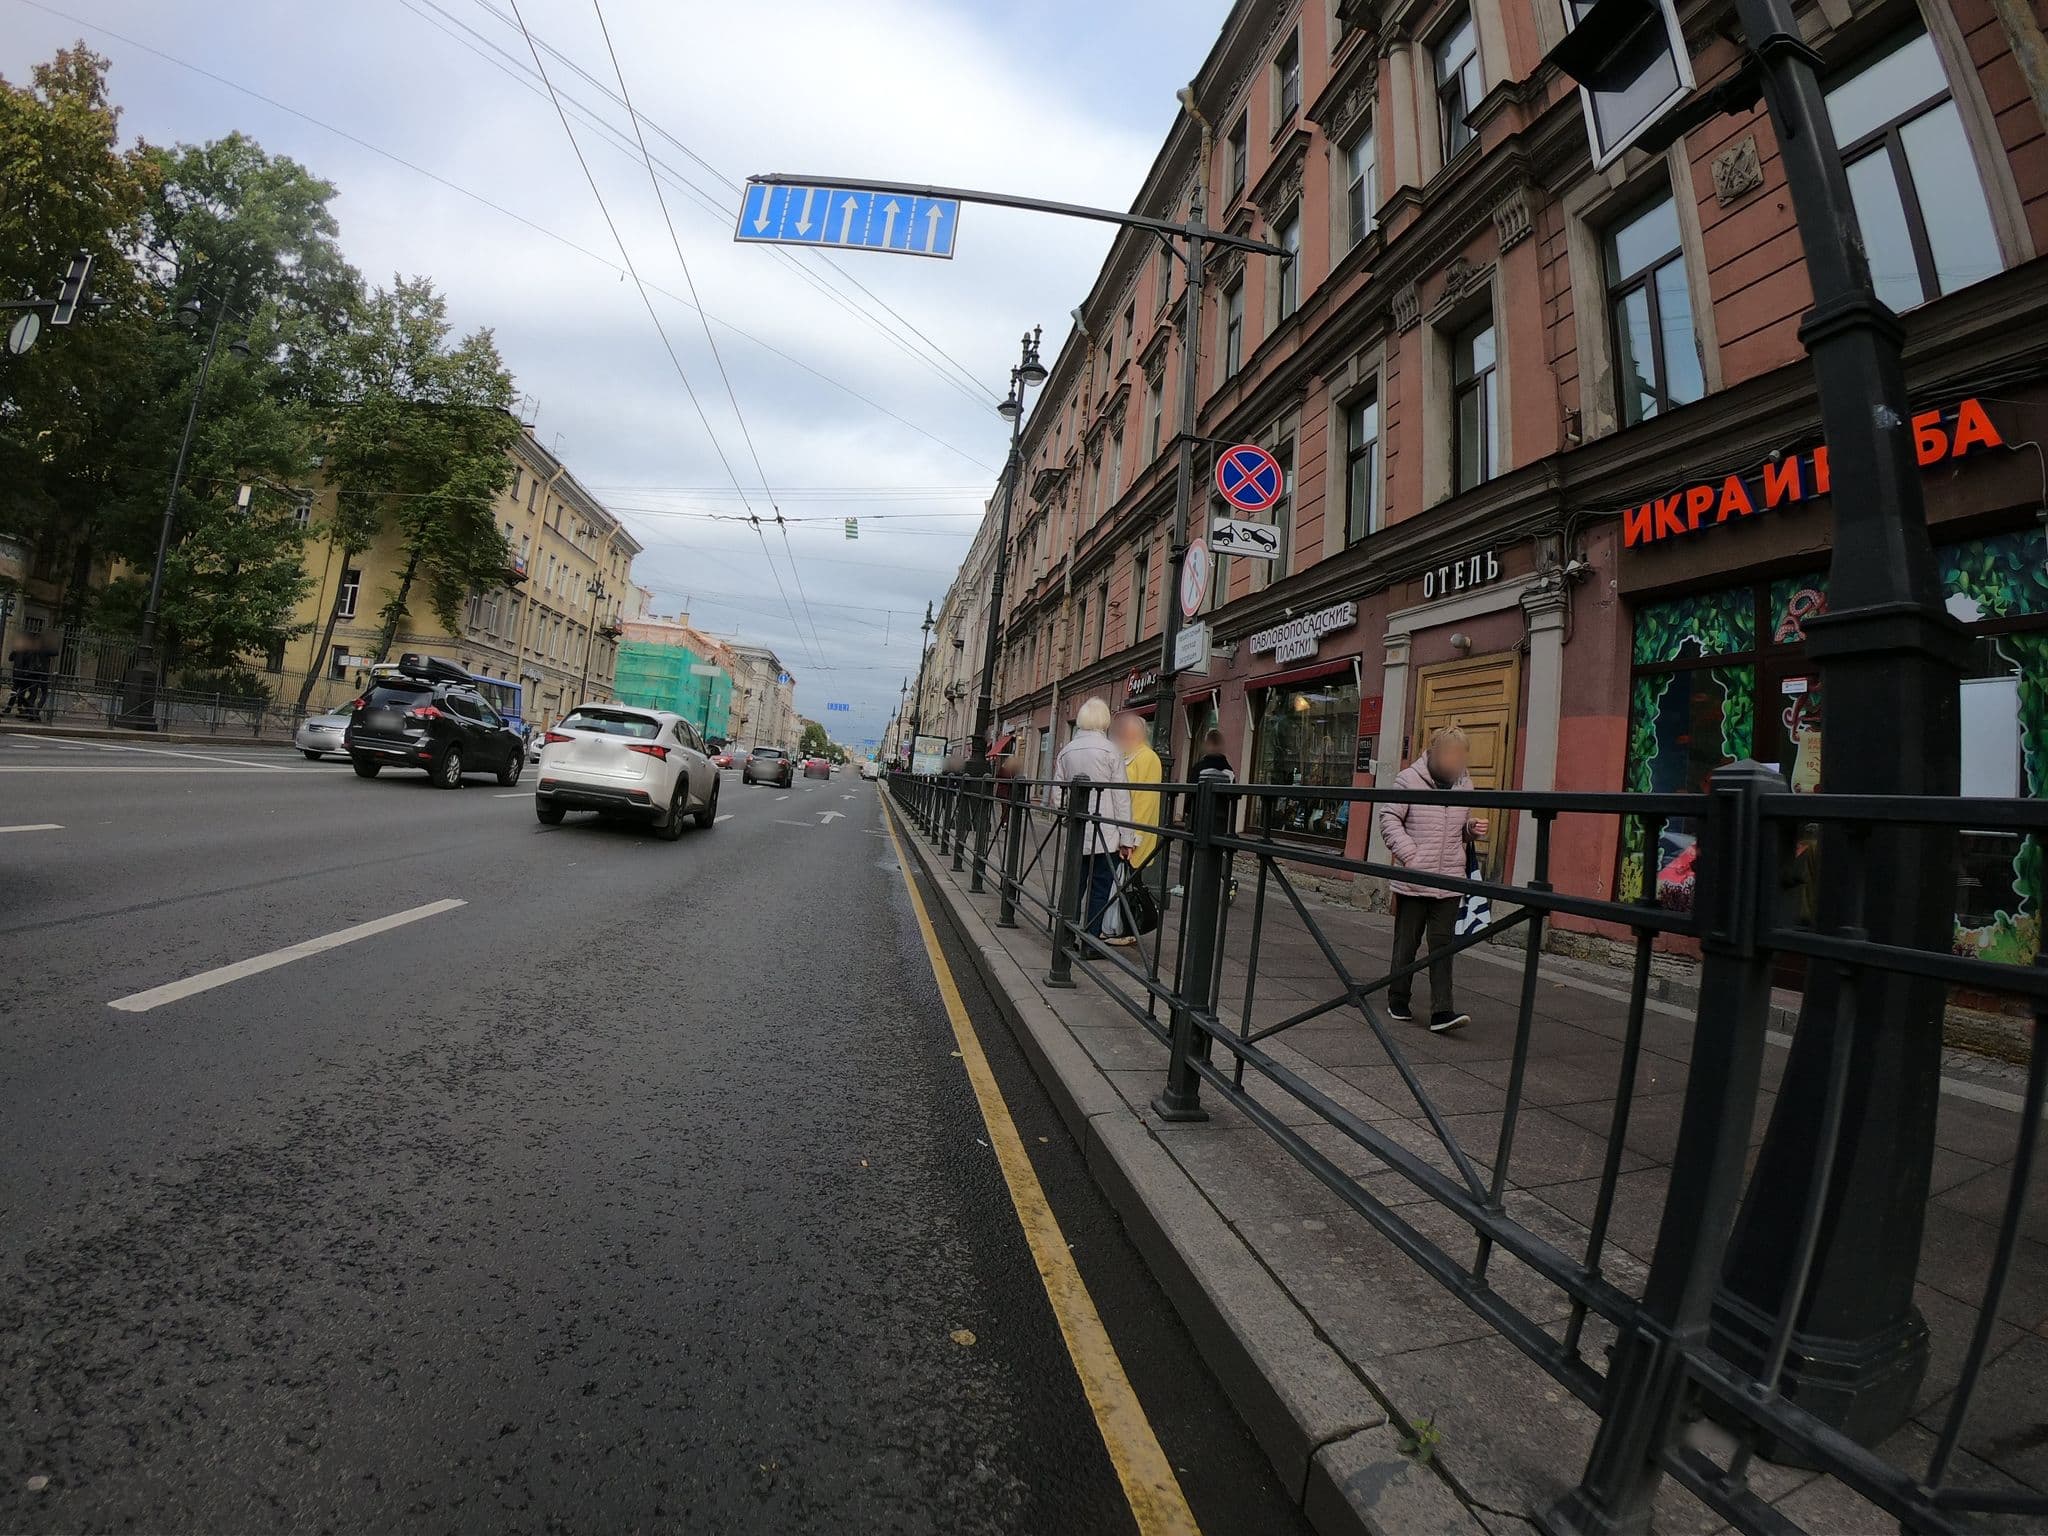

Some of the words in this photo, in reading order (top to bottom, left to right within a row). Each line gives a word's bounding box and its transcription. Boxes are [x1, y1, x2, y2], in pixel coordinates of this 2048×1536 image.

[1622, 474, 1753, 548] ИКРА
[1763, 455, 1801, 508] И
[1423, 550, 1499, 599] ОТЕЛЬ
[1251, 604, 1350, 652] ПАВЛОВОПОСАДСКИЕ
[1276, 638, 1312, 662] ПЛАТКИ
